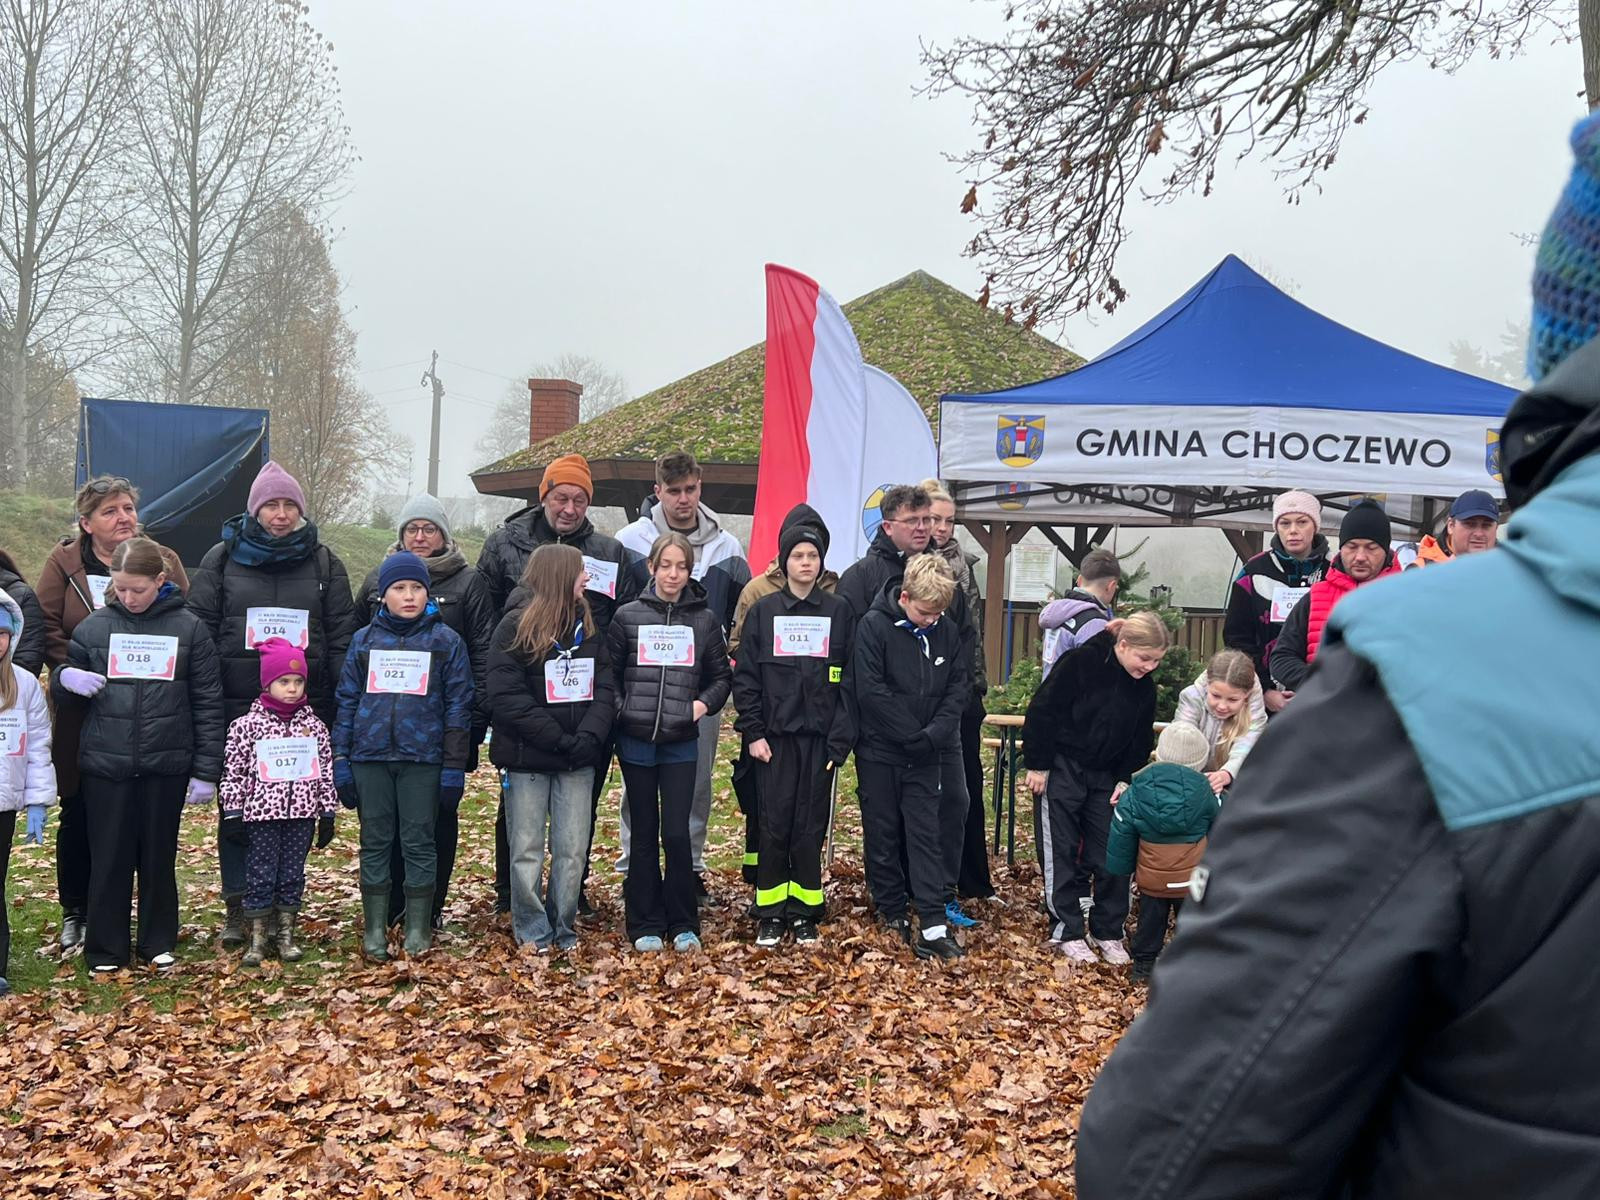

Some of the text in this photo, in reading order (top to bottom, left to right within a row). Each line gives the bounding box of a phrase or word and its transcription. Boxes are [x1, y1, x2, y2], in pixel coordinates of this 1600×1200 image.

[1076, 428, 1451, 468] GMINA CHOCZEWO
[263, 625, 286, 635] 014
[789, 634, 810, 642] 011
[653, 642, 674, 651] 020
[126, 653, 151, 663] 018
[384, 670, 406, 679] 021
[0, 731, 6, 741] 3
[275, 757, 298, 768] 017
